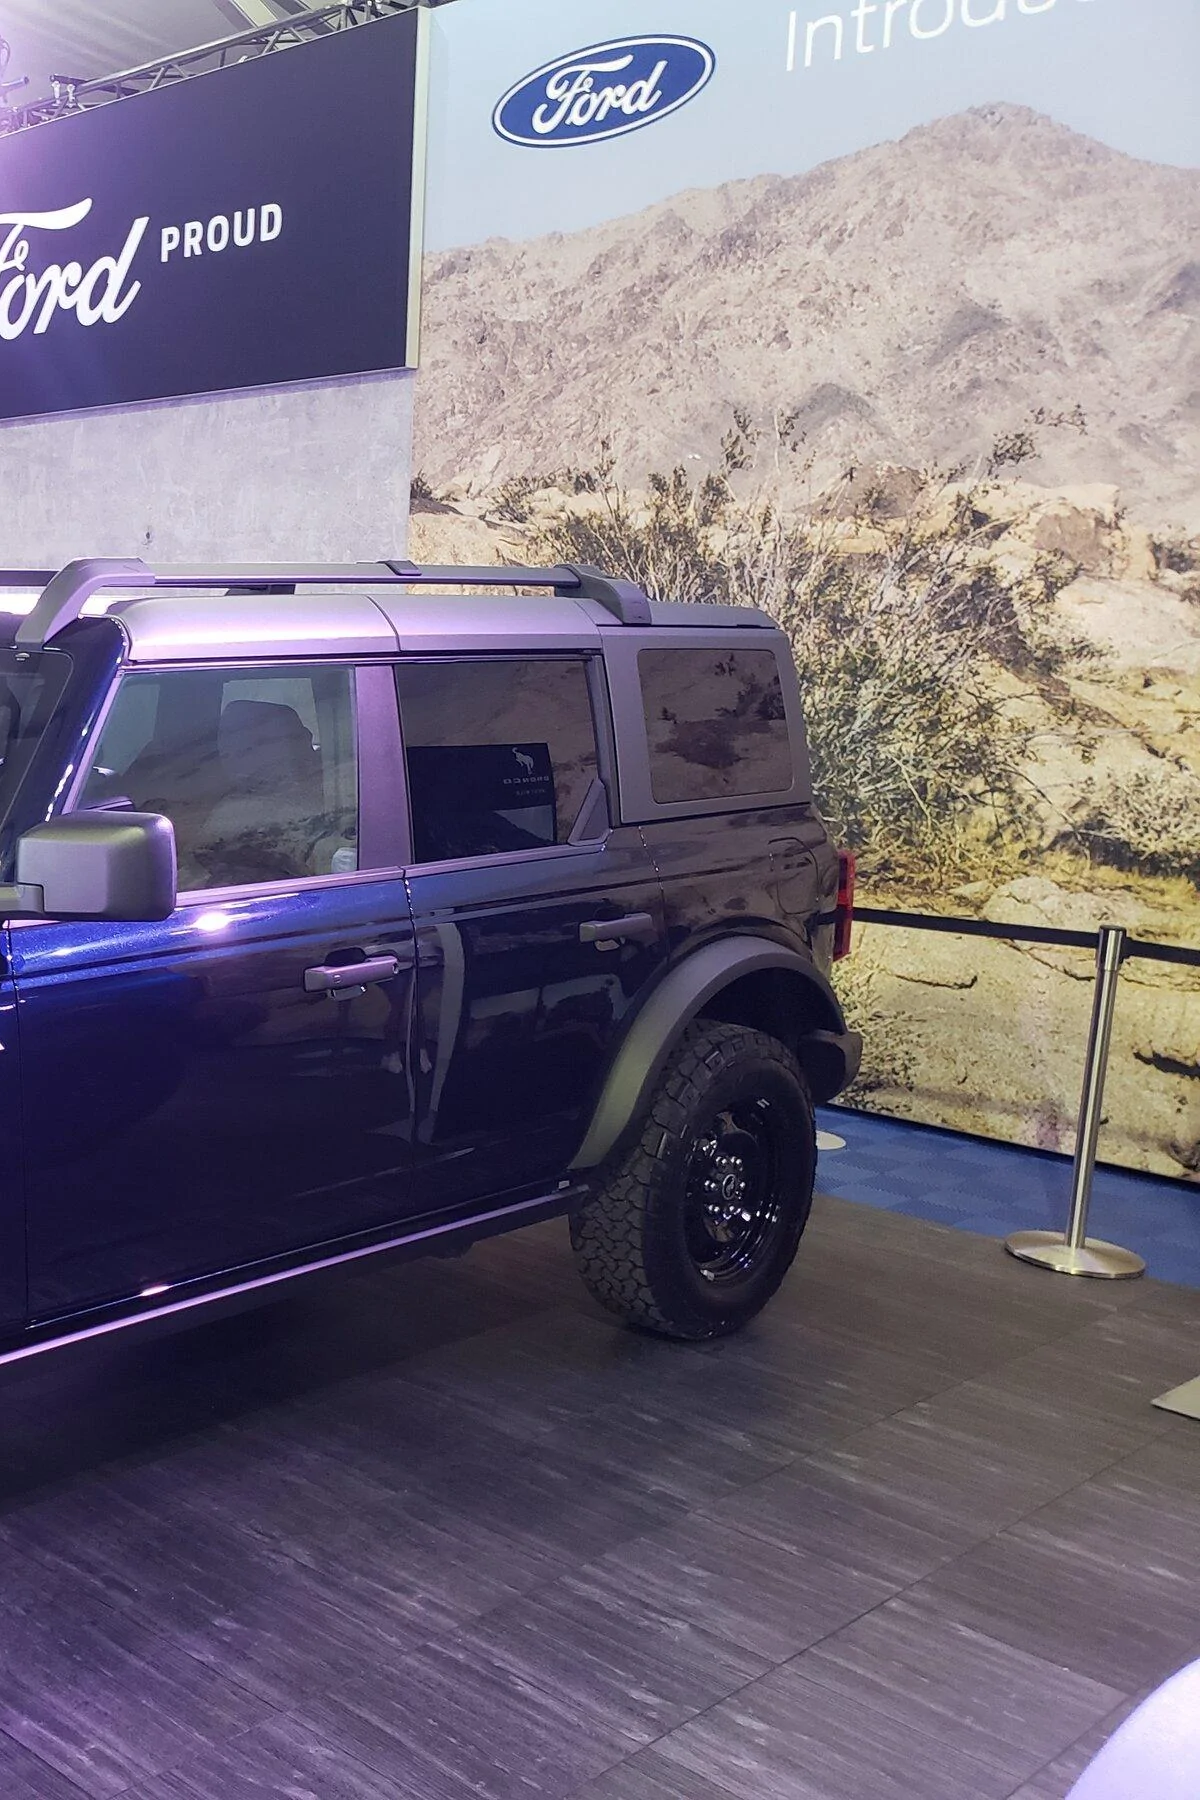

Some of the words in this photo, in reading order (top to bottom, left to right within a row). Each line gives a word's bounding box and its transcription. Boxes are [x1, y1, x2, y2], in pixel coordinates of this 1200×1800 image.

[786, 0, 1096, 72] Intro
[531, 54, 668, 134] Ford
[161, 203, 283, 263] PROUD
